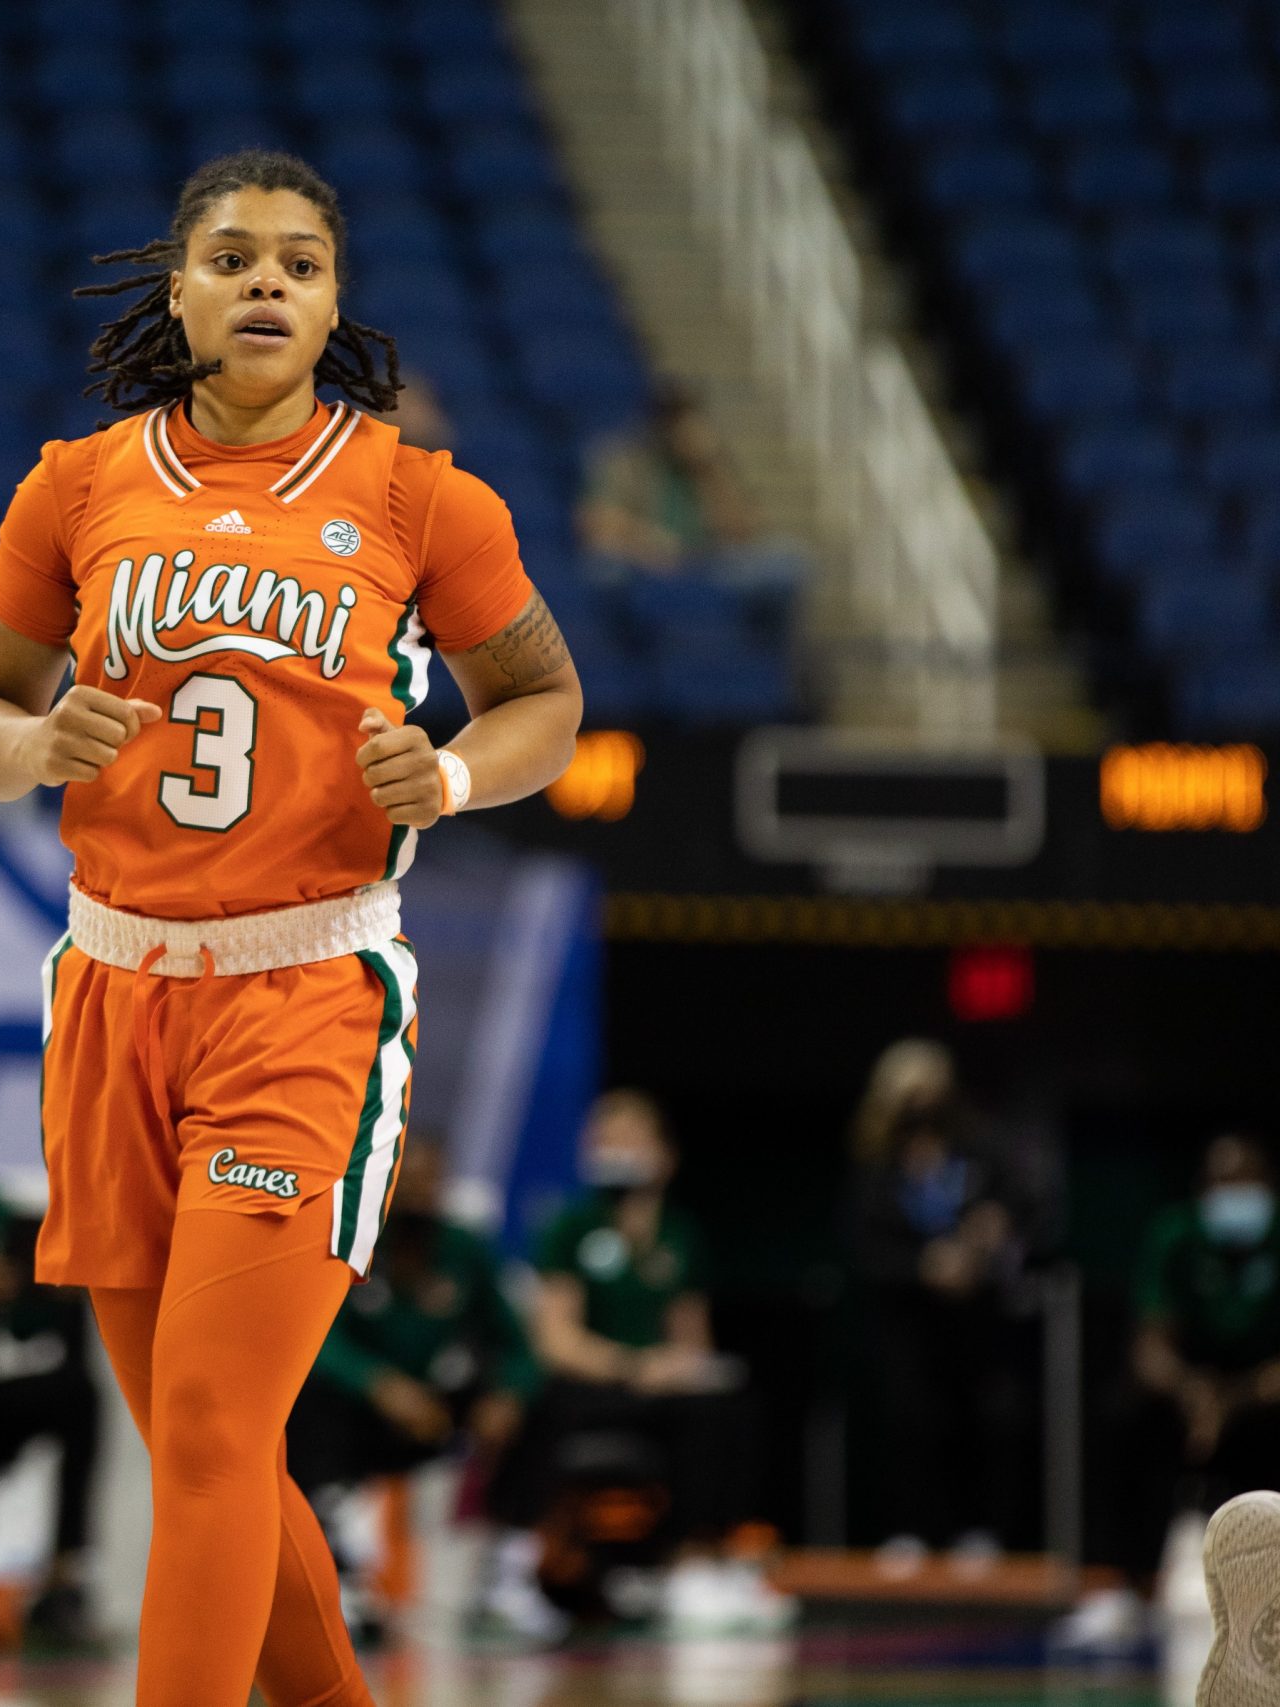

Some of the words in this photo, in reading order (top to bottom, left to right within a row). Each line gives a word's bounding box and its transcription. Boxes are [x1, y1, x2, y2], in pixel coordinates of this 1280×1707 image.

[205, 523, 252, 534] adidas
[327, 531, 358, 543] ACC
[104, 550, 357, 680] Miami
[157, 671, 258, 833] 3
[208, 1146, 300, 1199] Canes
